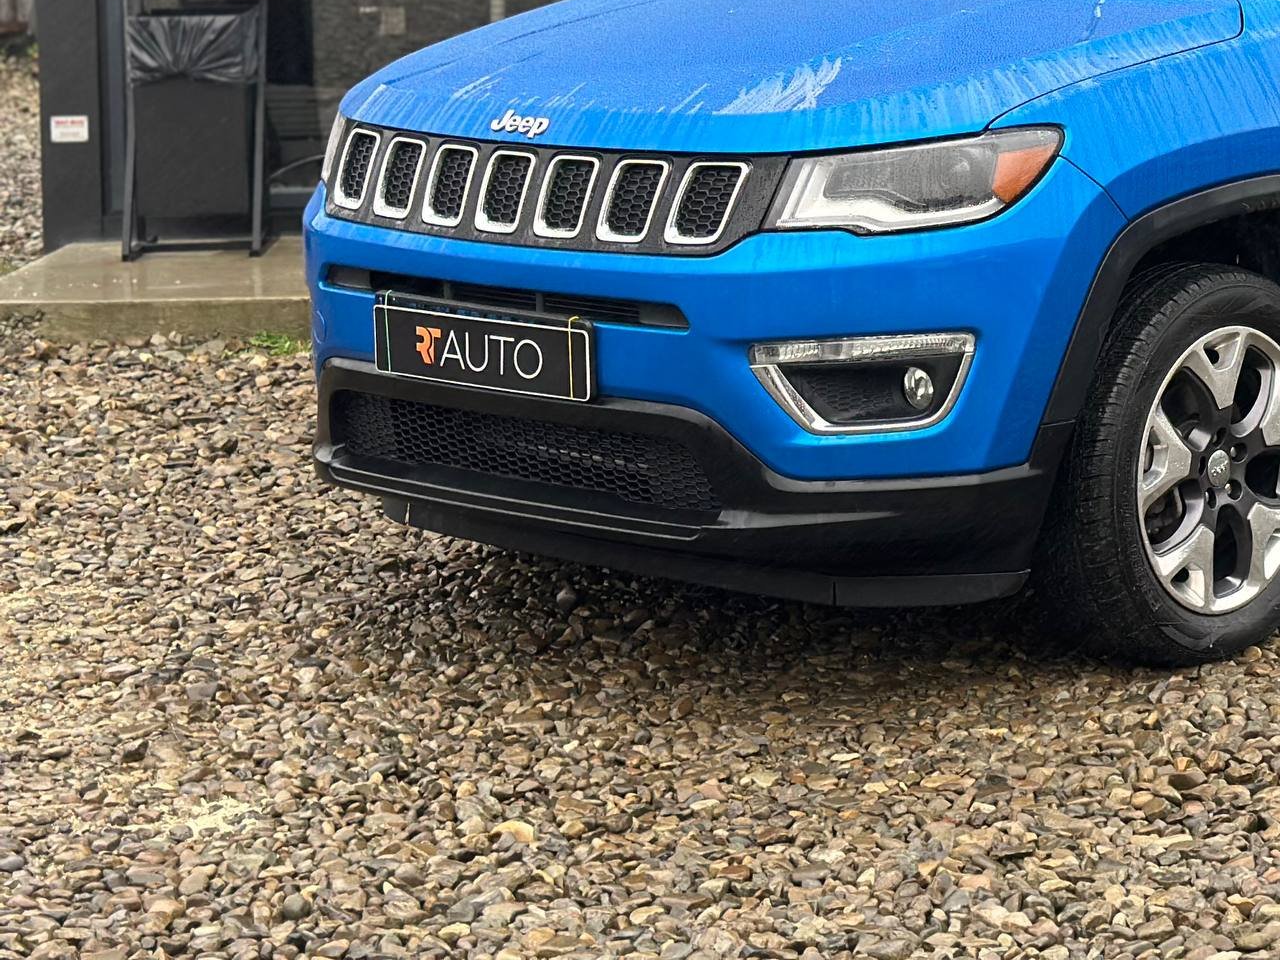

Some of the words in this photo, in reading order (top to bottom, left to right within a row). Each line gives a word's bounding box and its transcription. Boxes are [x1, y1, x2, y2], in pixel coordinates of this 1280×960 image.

[490, 108, 550, 139] Jeep
[415, 325, 442, 365] RT
[439, 329, 543, 379] AUTO
